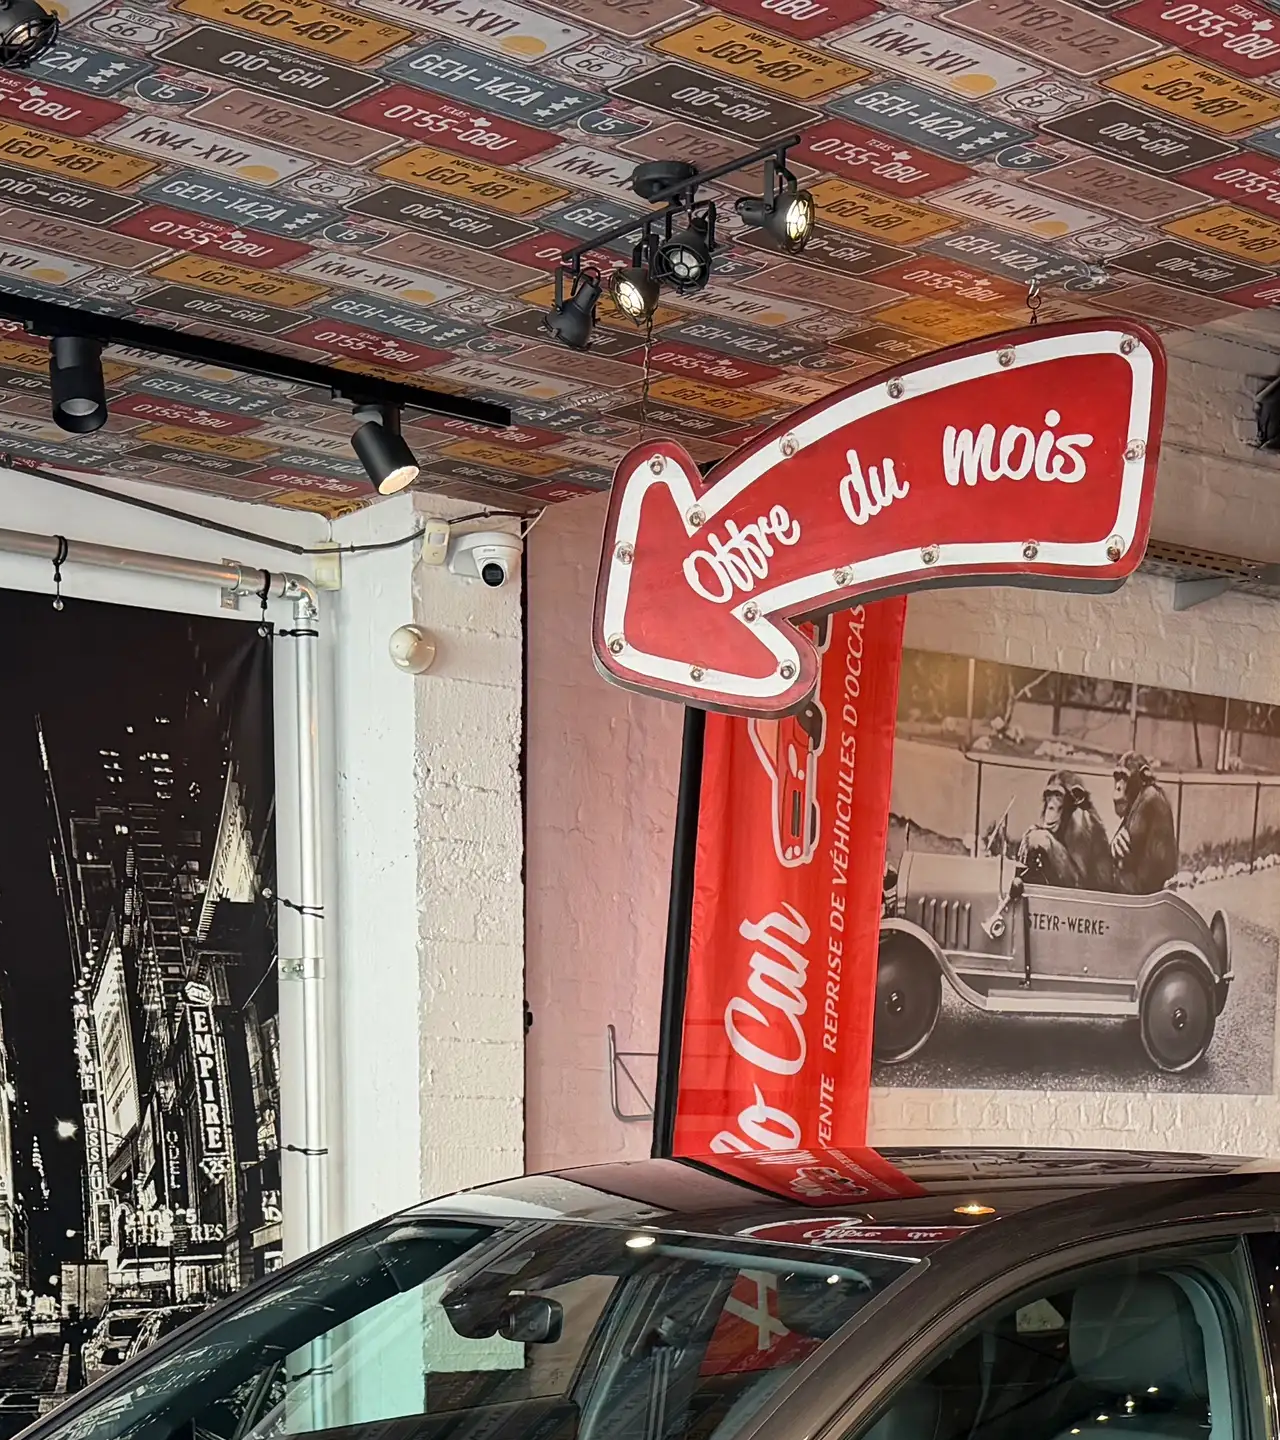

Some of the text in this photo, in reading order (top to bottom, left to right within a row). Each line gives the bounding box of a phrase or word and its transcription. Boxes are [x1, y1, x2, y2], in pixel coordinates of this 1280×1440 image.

[1226, 4, 1258, 20] TEXAS
[106, 25, 140, 38] 66
[577, 57, 605, 72] 66
[744, 31, 832, 67] NEW YORK
[861, 28, 980, 76] KN4-XV1
[155, 85, 187, 100] 15
[408, 54, 544, 108] GEH-142A
[1193, 71, 1266, 102] NEW YORK
[437, 104, 471, 117] TEXAS
[590, 117, 618, 131] 15
[854, 91, 976, 141] GEH-142A
[22, 130, 64, 144] NEW
[864, 138, 894, 152] TEXAS
[450, 159, 490, 173] NEW
[1009, 151, 1032, 164] 15
[855, 190, 892, 206] NEW
[682, 409, 1094, 604] Offre du mois
[827, 739, 858, 889] VÉHICULES
[829, 895, 847, 927] DE
[723, 901, 811, 1077] Car
[822, 934, 844, 1054] REPRISE
[193, 1011, 223, 1149] EMPIRE
[818, 1074, 835, 1150] VENTE
